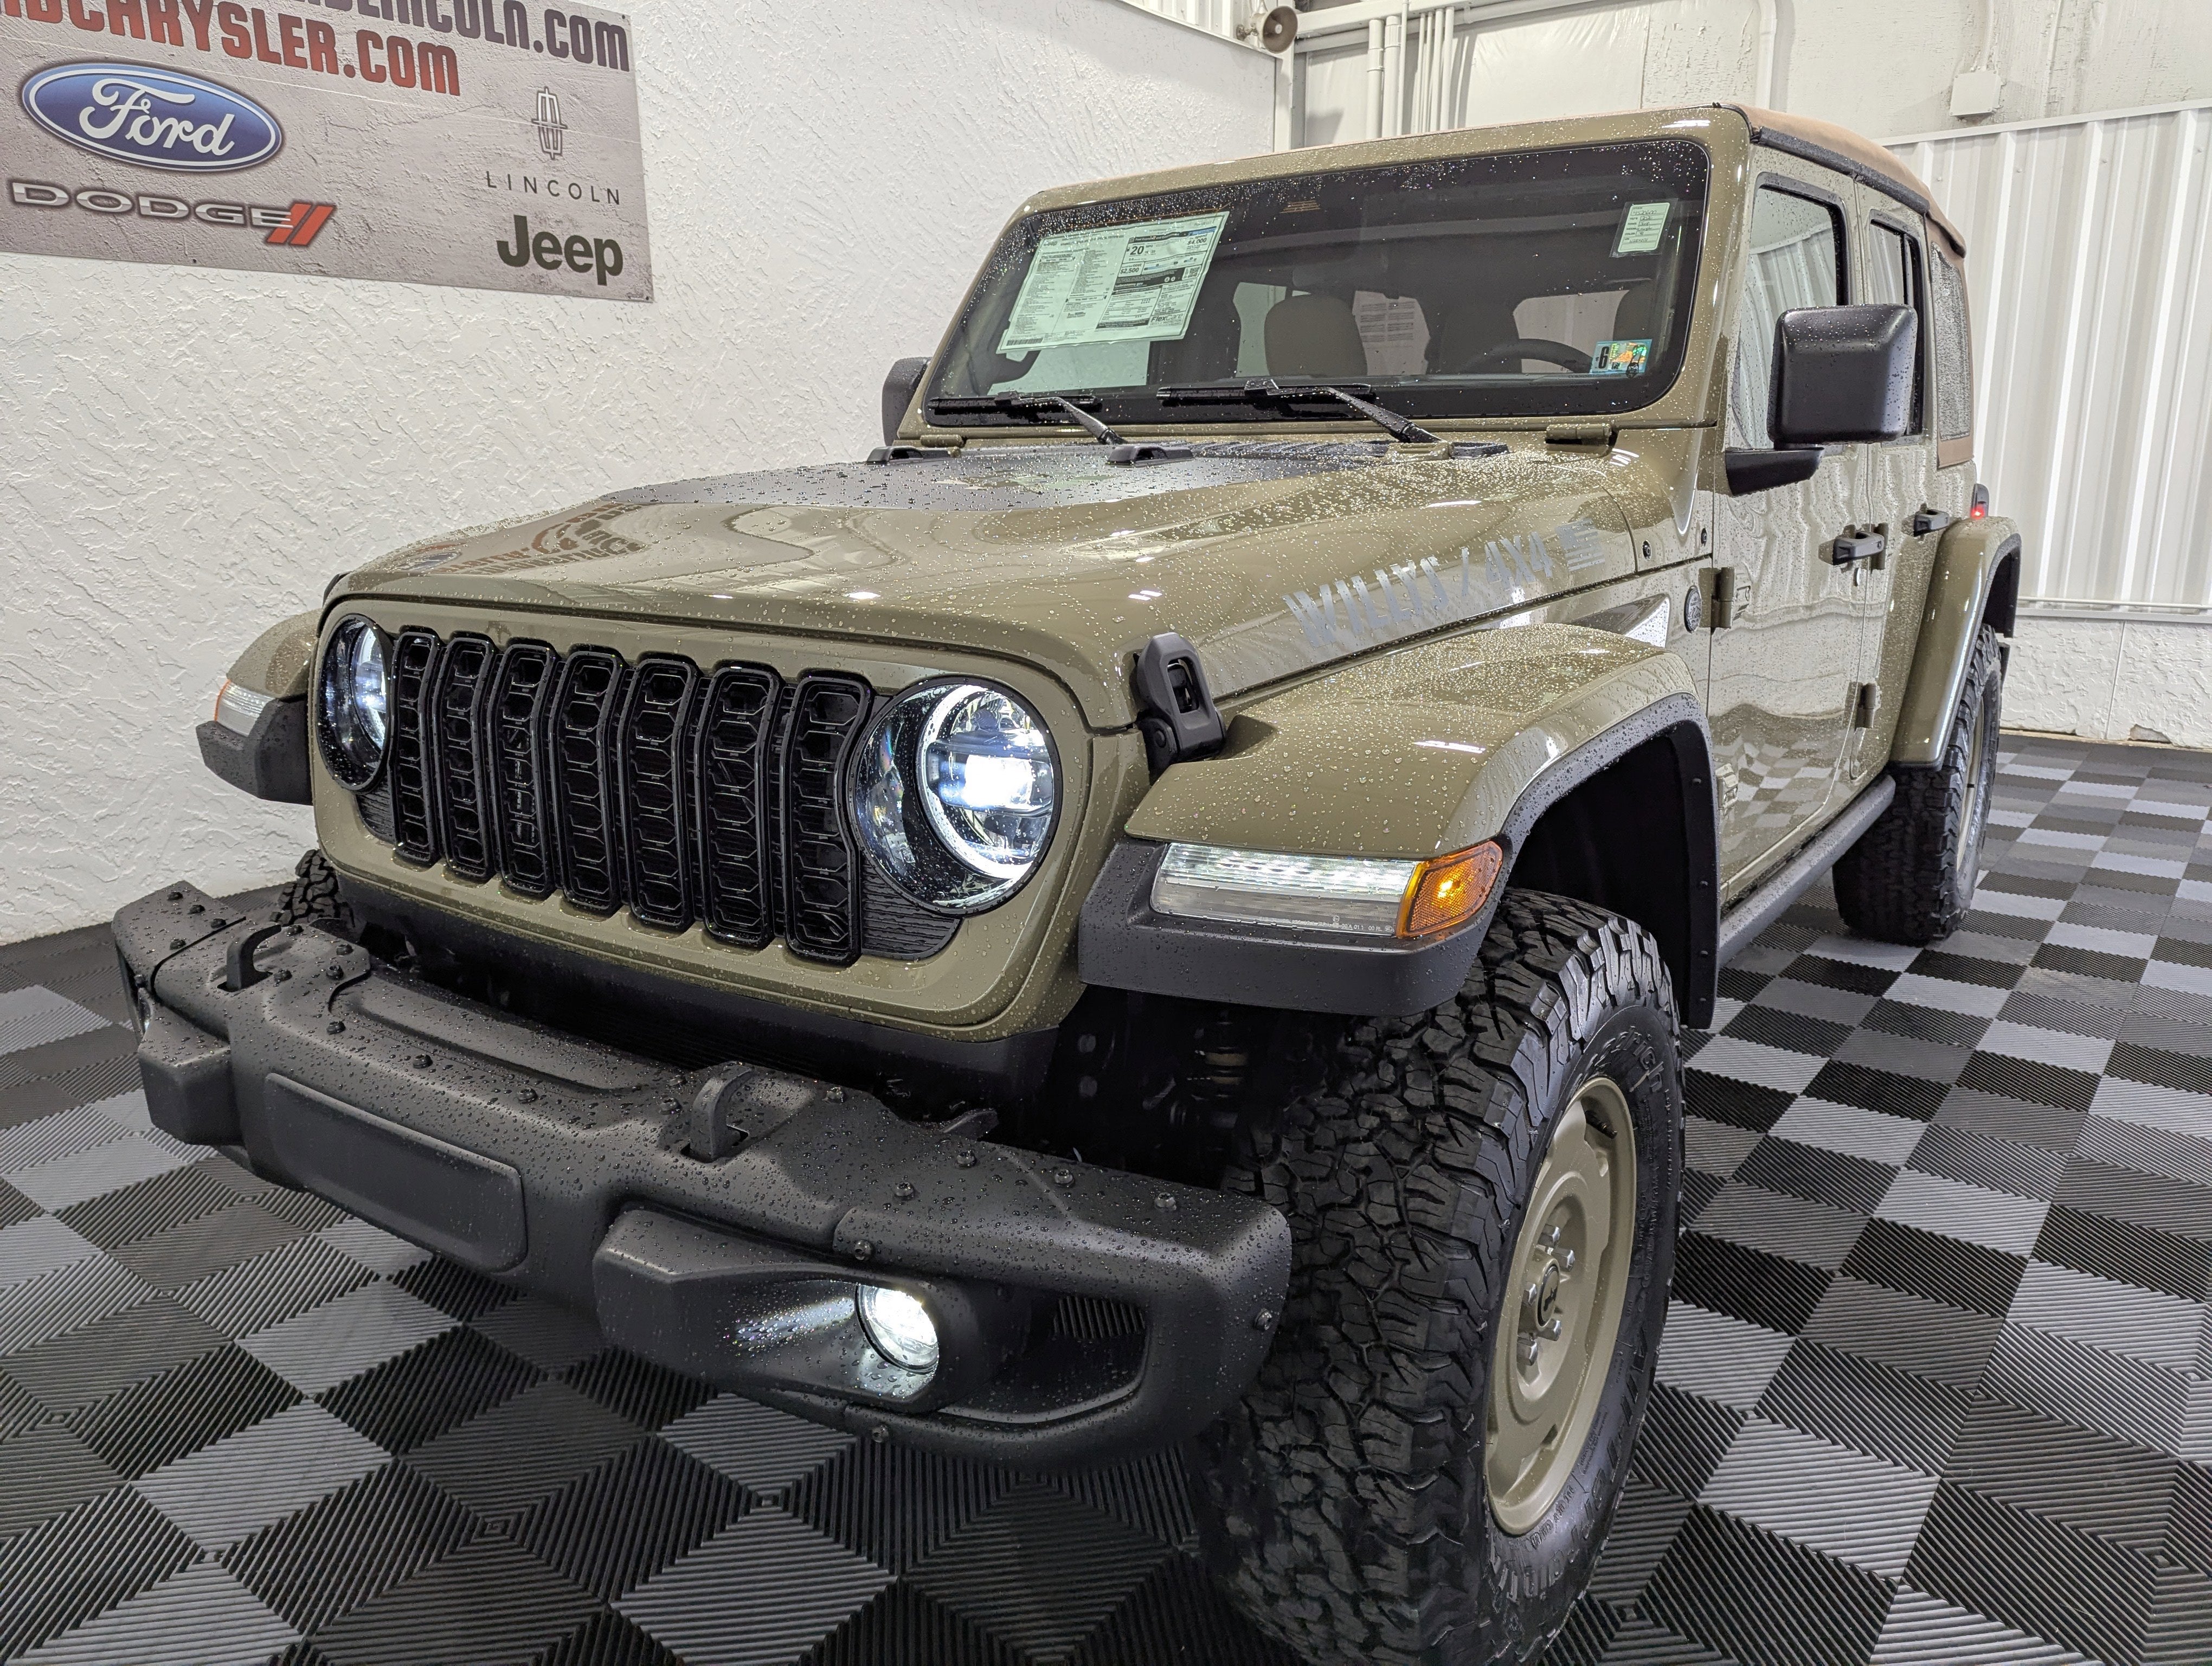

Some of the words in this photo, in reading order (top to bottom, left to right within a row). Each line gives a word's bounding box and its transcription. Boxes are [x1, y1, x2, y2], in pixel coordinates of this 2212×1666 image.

[79, 79, 235, 155] Ford
[12, 182, 294, 228] DODGE
[486, 170, 619, 205] LINCOLN
[496, 214, 623, 286] Jeep
[1130, 246, 1144, 255] 20
[1598, 346, 1610, 369] 6
